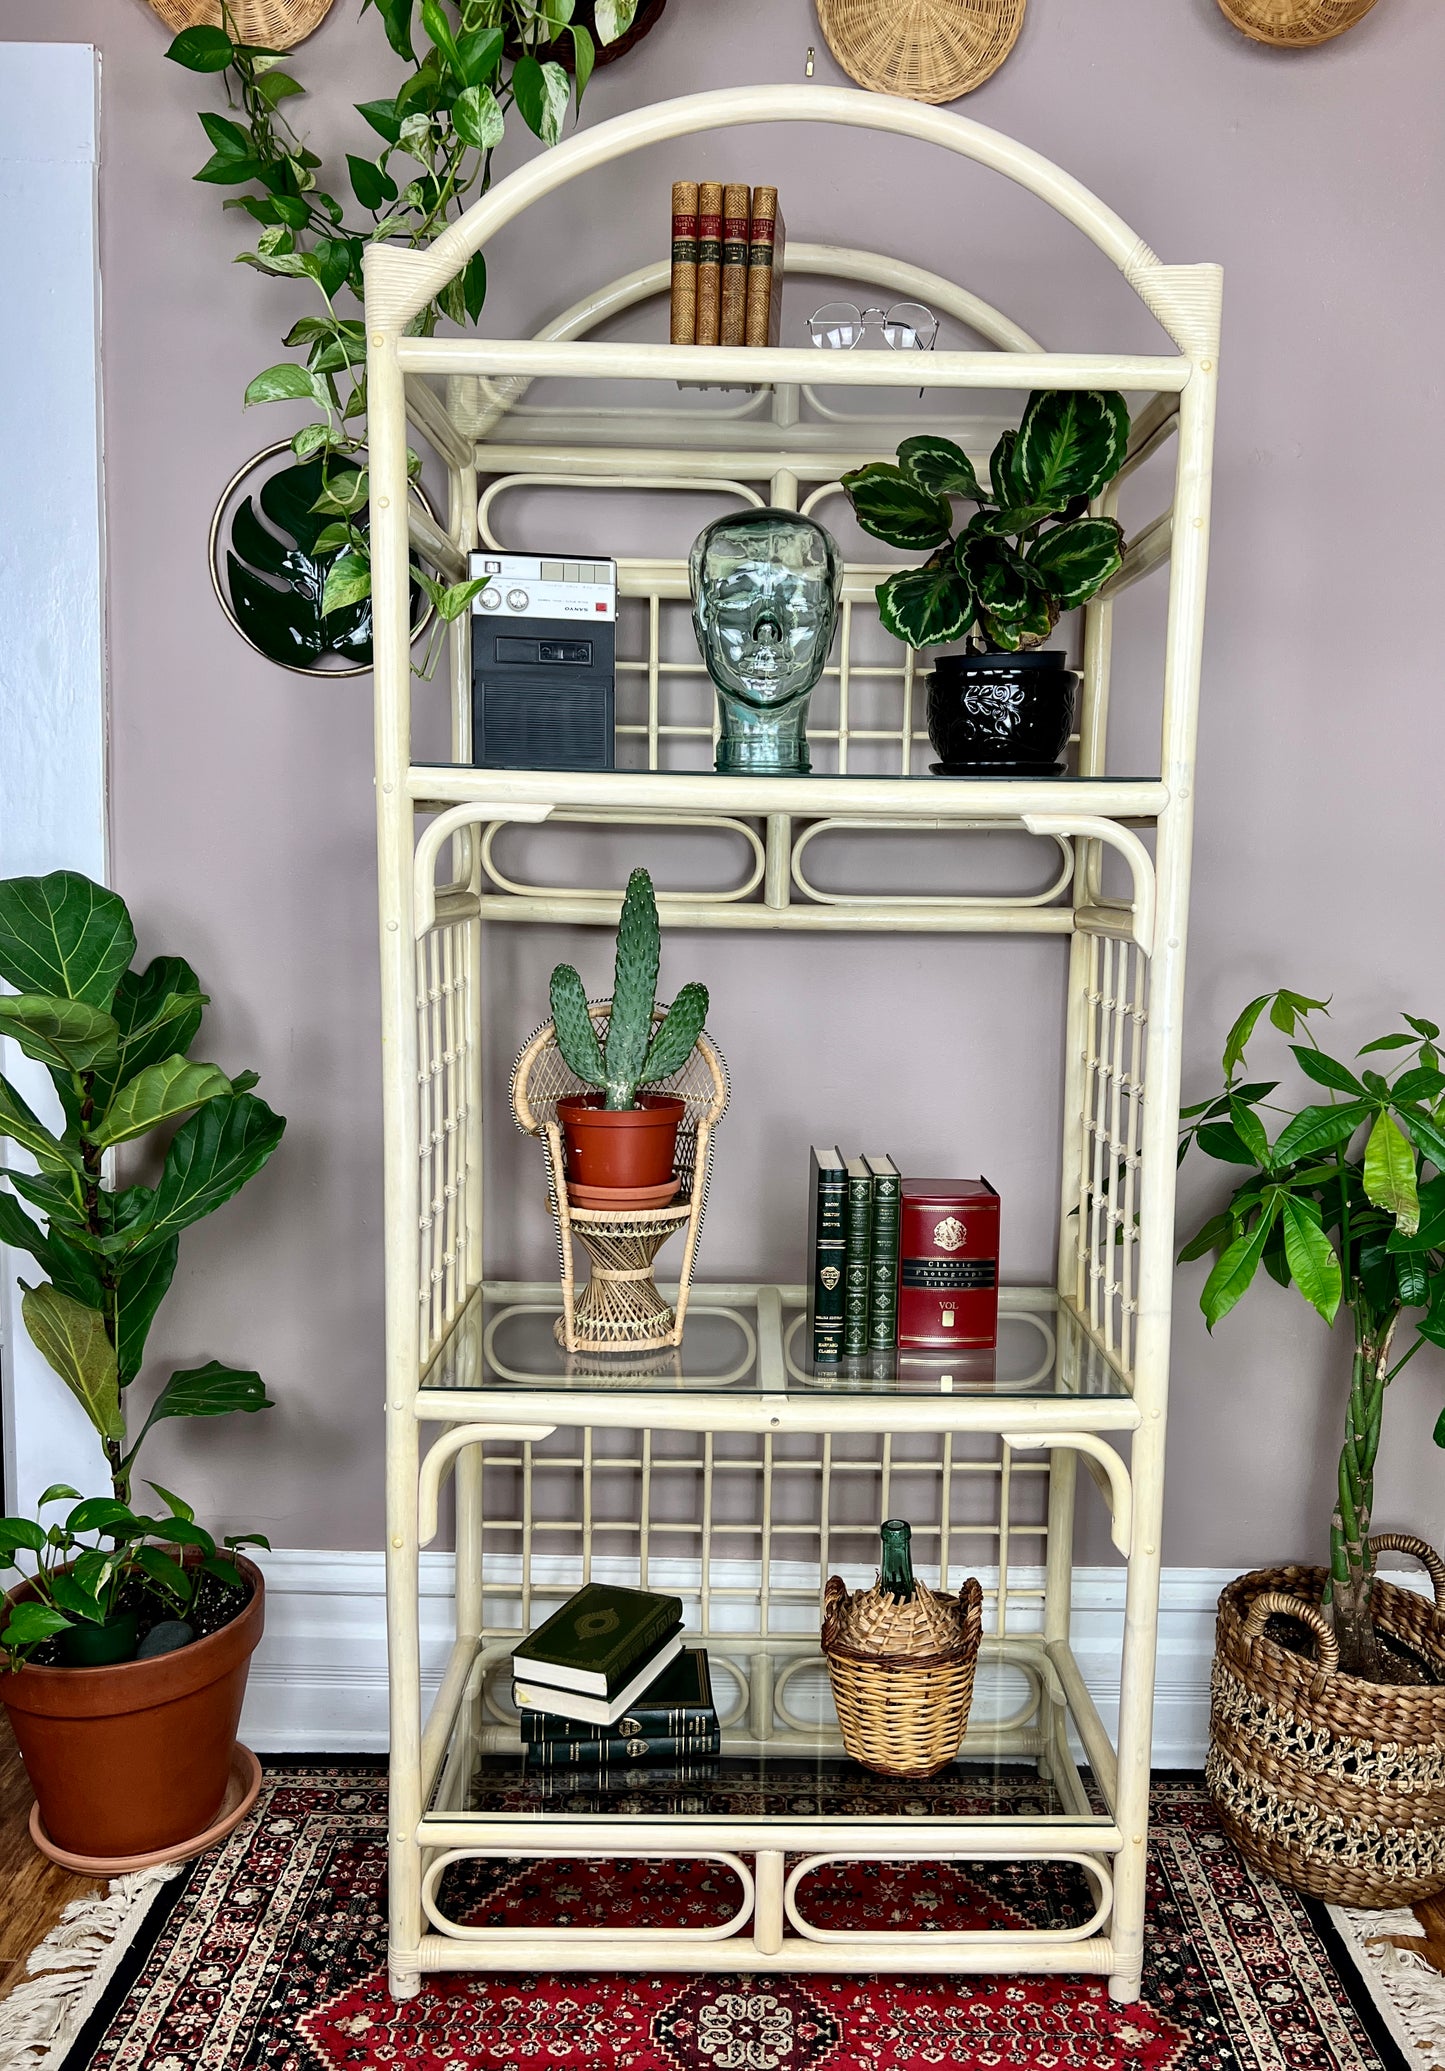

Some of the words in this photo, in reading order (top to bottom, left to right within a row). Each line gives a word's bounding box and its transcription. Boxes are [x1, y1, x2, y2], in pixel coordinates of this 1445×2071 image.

[915, 1269, 983, 1278] Photograph
[926, 1280, 972, 1288] Library
[938, 1301, 959, 1310] VOL
